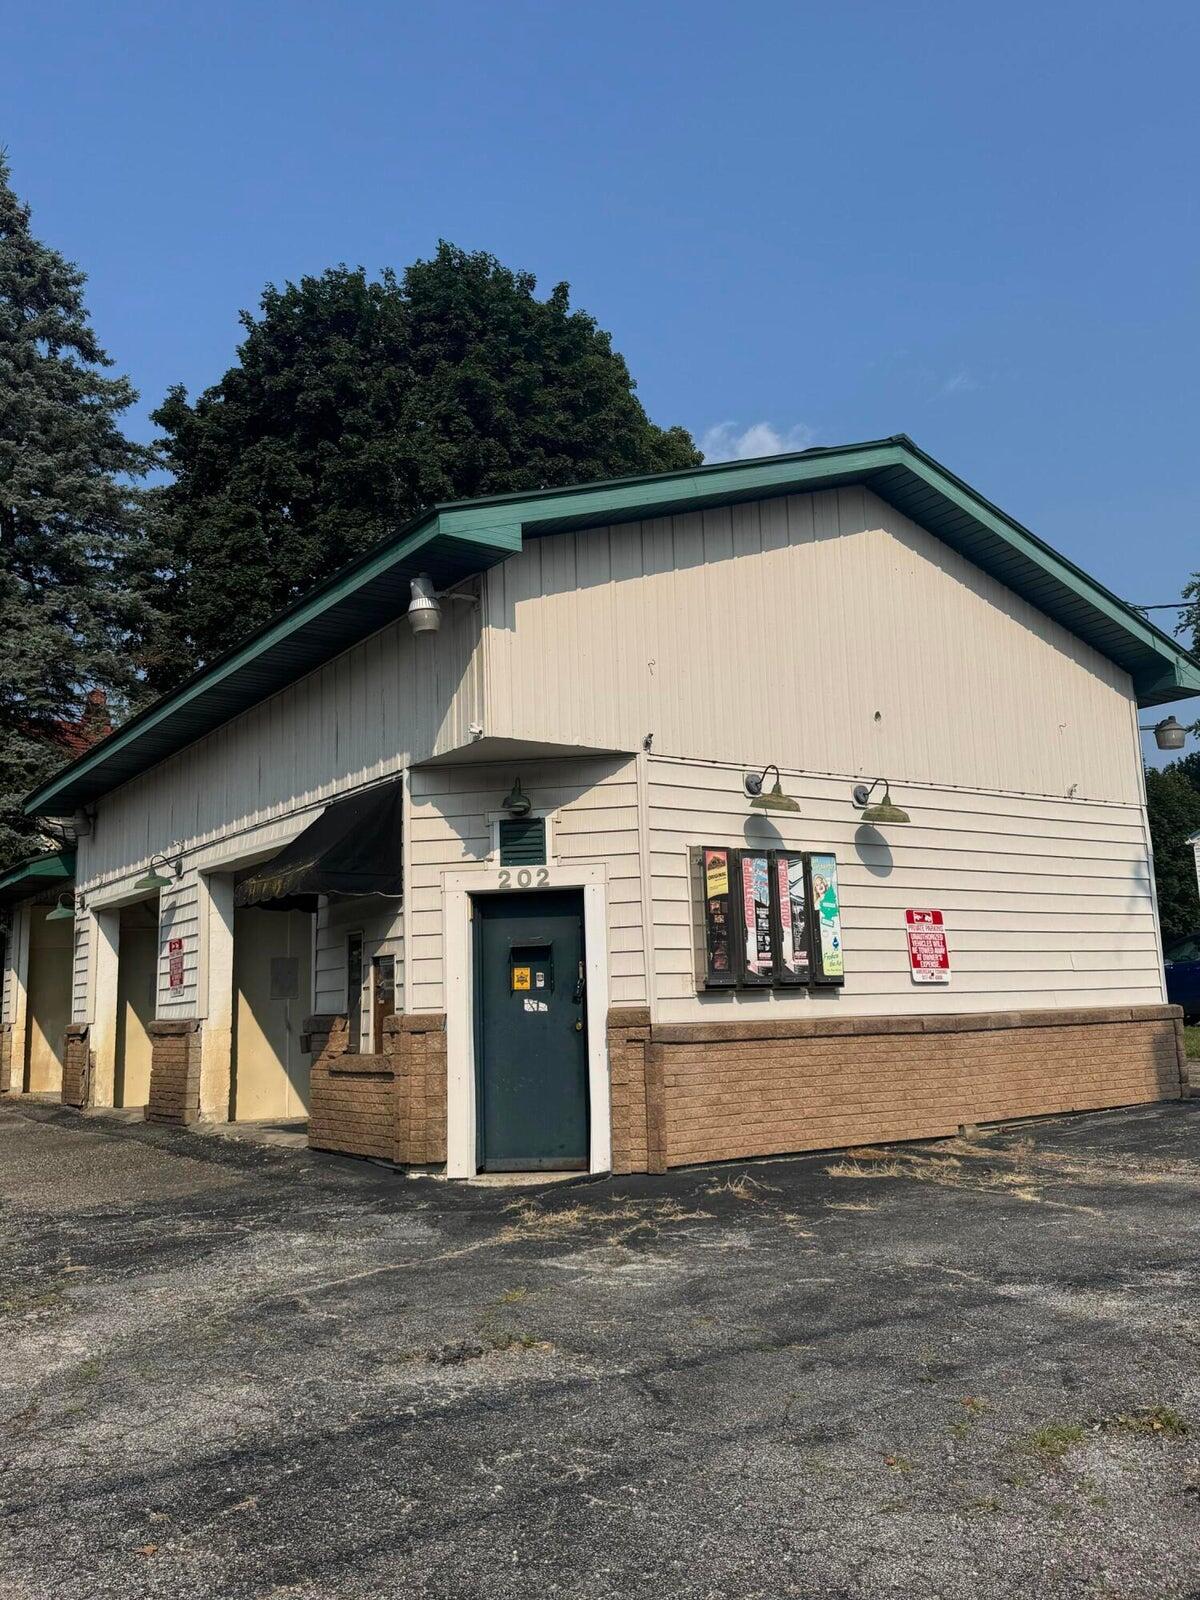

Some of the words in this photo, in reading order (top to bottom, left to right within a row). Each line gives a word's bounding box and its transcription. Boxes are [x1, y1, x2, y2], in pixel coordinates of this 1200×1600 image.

[498, 868, 550, 888] 202
[779, 861, 788, 899] TOWELS
[781, 901, 790, 928] AQUA
